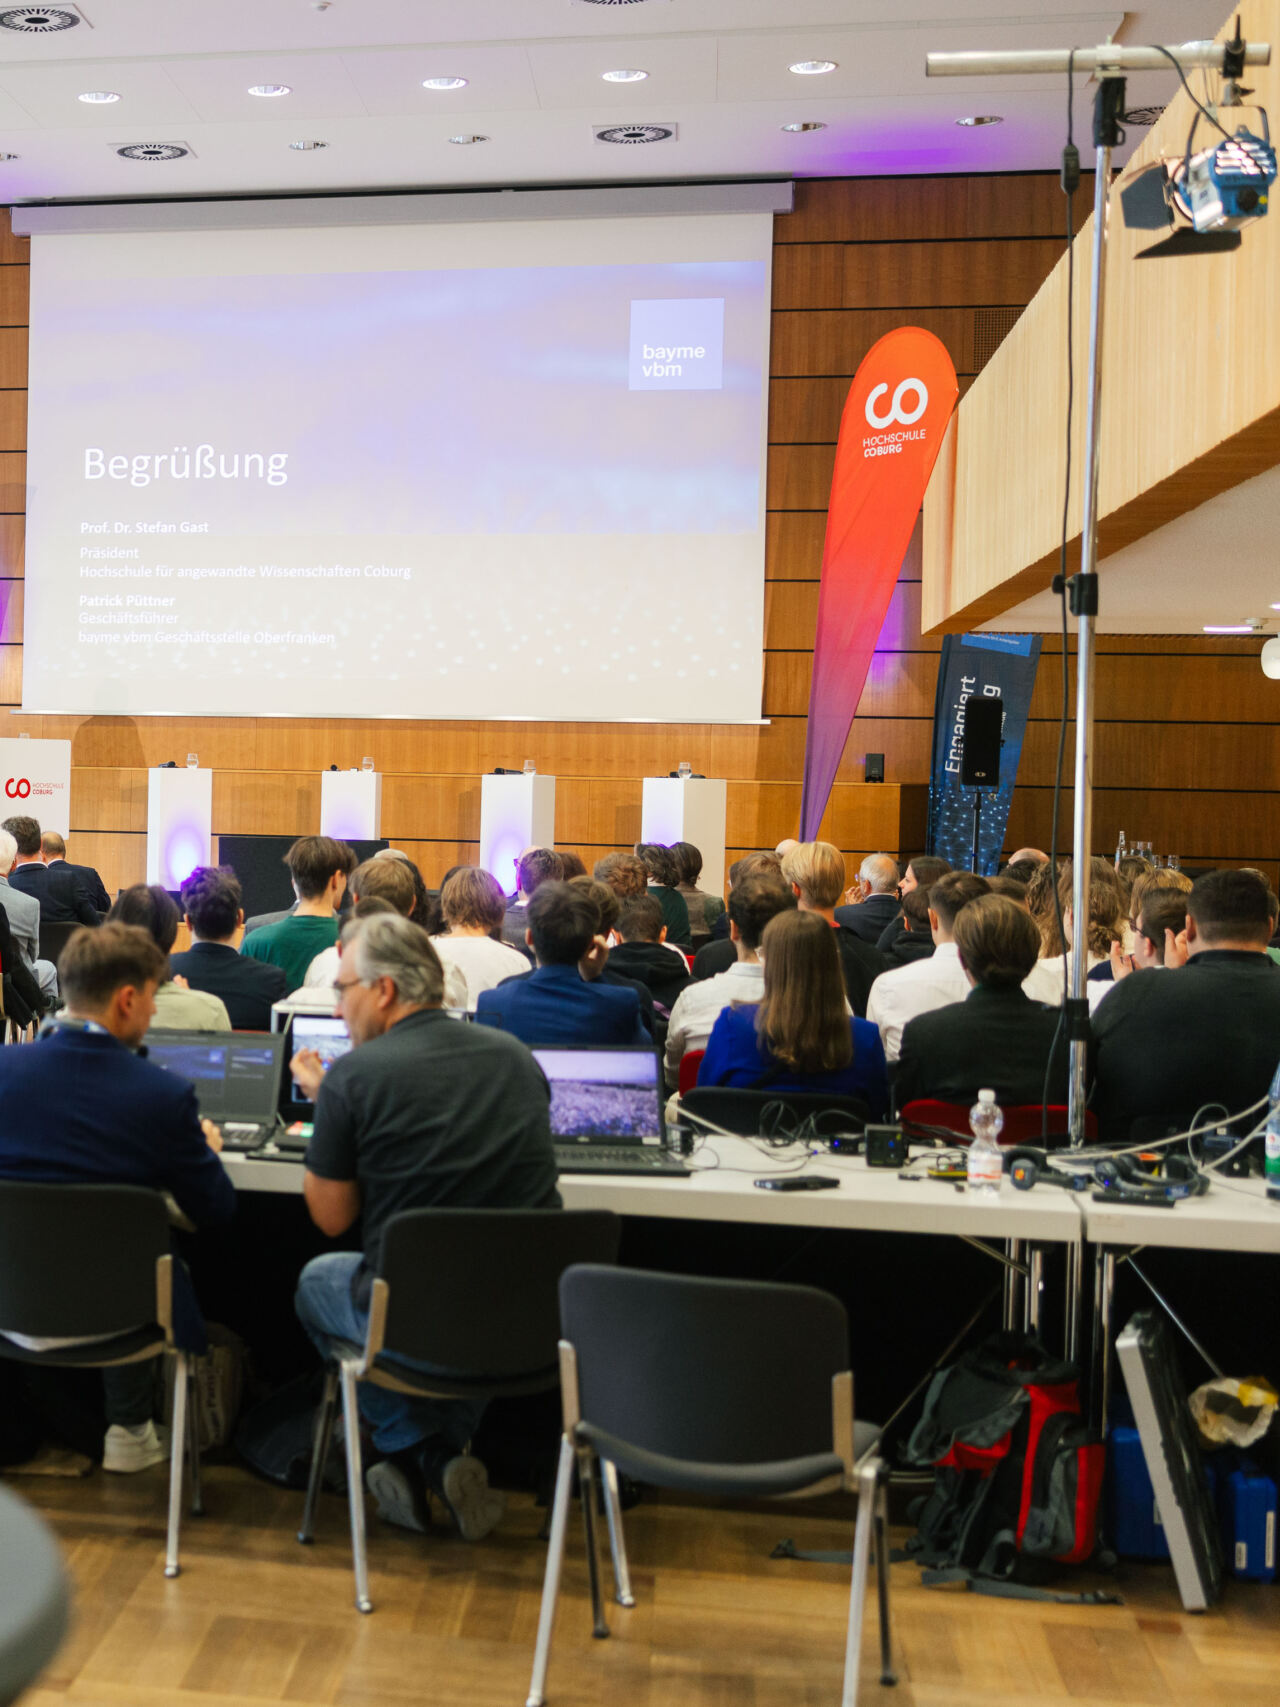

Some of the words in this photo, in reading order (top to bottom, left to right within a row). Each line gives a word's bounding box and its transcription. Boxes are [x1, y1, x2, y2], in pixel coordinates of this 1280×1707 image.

[643, 344, 705, 363] bayme
[642, 361, 682, 377] vbm
[862, 429, 927, 448] HOCHSCHULE
[864, 443, 903, 458] COBURG
[84, 444, 289, 487] Begrüßung
[80, 521, 111, 534] Prof.
[114, 522, 132, 533] Dr.
[135, 521, 177, 533] Stefan
[180, 521, 209, 533] Gast
[80, 546, 139, 559] Präsident
[79, 564, 152, 577] Hochschule
[155, 564, 174, 577] für
[177, 565, 256, 580] angewandte
[259, 564, 360, 577] Wissenschaften
[364, 564, 412, 580] Coburg
[79, 594, 122, 607] Patrick
[126, 594, 176, 607] Püttner
[79, 612, 178, 624] Geschäftsführer
[78, 631, 120, 645] bayme
[124, 631, 151, 643] vbm
[155, 631, 250, 643] Geschäftsstelle
[254, 631, 335, 644] Oberfranken
